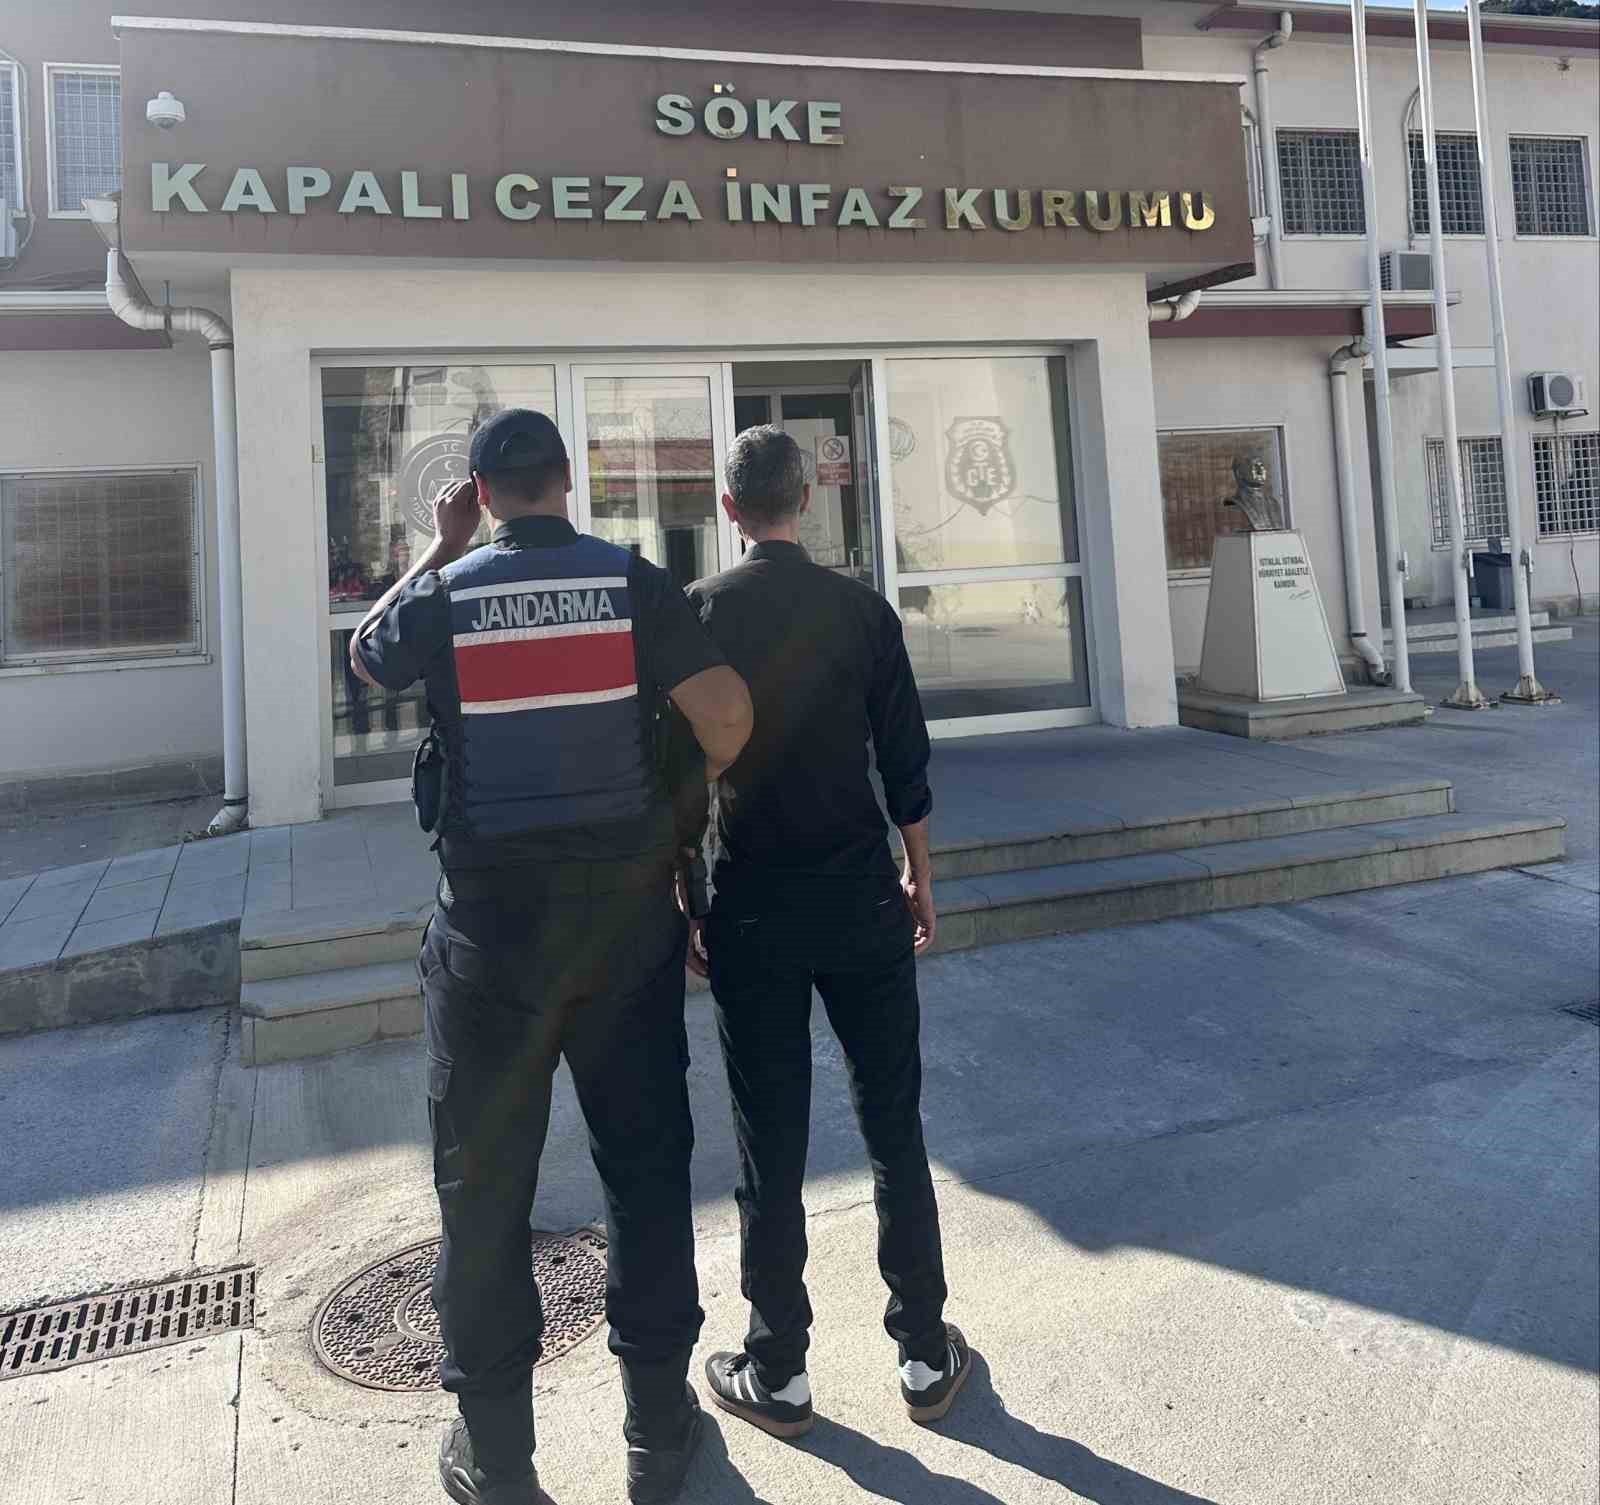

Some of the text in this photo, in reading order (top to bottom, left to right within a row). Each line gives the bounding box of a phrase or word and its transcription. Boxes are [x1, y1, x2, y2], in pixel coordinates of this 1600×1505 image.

[656, 82, 844, 145] SÖKE
[151, 162, 1216, 232] KAPALI CEZA İNFAZ KURUMU
[471, 589, 617, 632] JANDARMA
